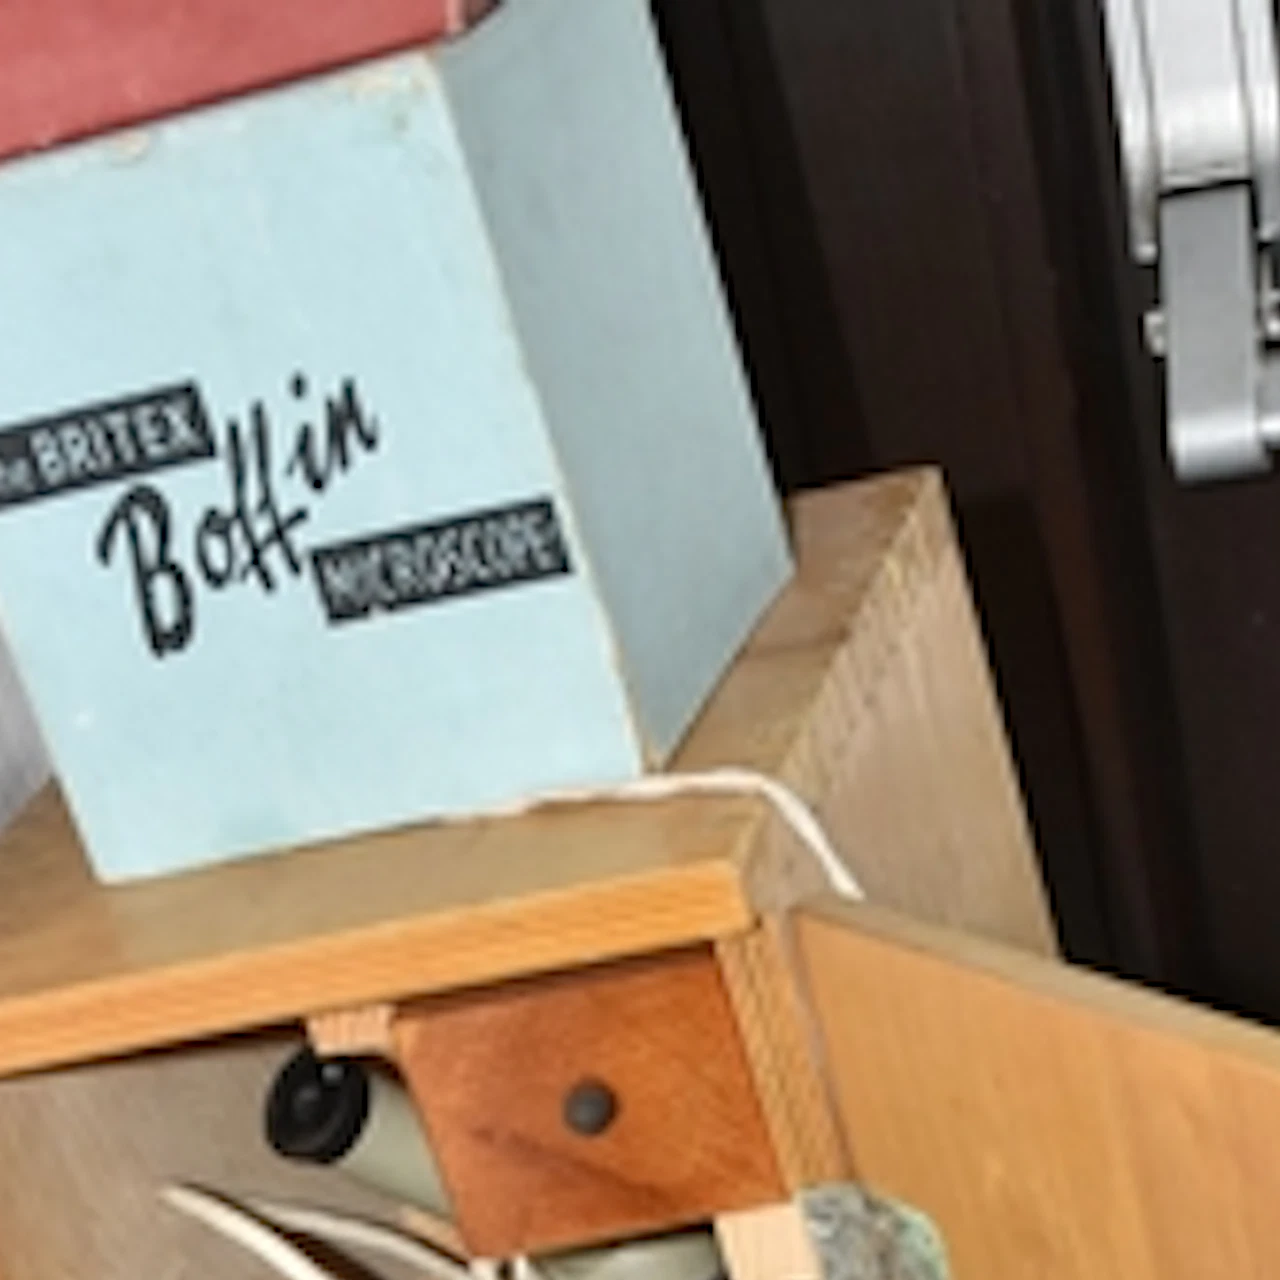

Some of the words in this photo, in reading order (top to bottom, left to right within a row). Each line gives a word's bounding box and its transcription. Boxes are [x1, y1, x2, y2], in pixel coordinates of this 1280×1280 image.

[28, 398, 206, 488] BRITEX
[96, 370, 378, 658] Boffin
[320, 508, 558, 612] MICROSCOPE
